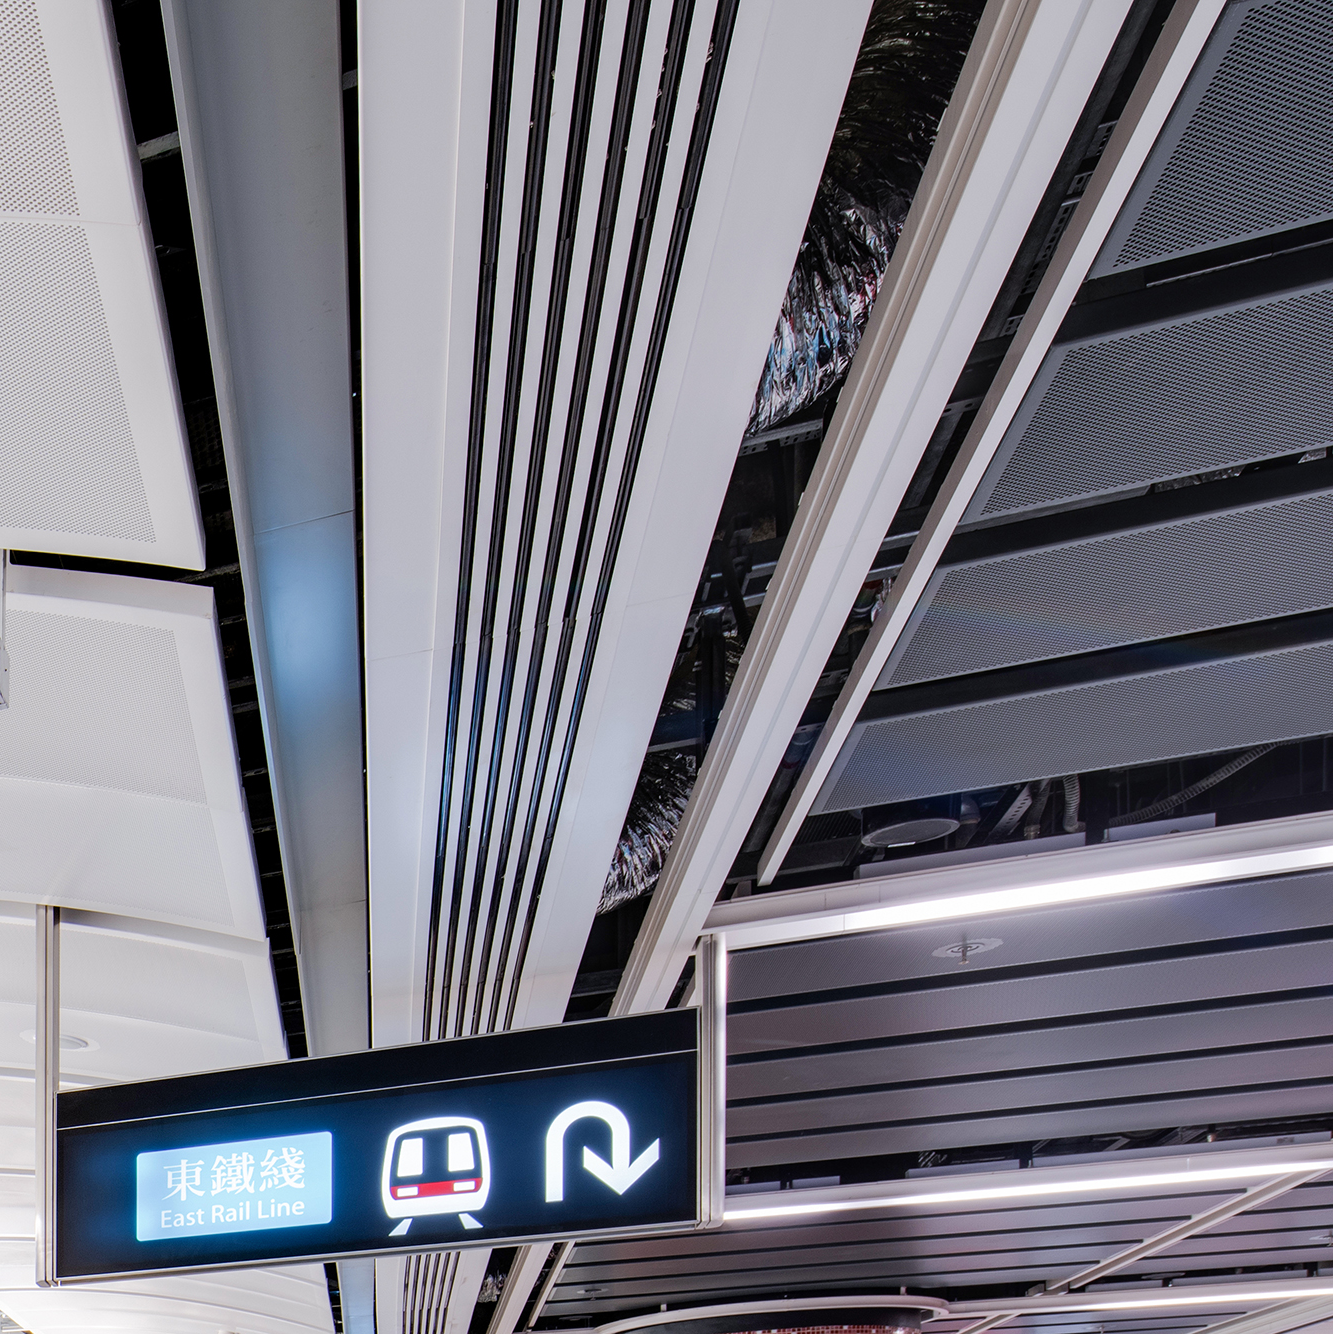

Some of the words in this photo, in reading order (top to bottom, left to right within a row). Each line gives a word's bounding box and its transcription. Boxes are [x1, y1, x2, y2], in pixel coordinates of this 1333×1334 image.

[162, 1147, 306, 1201] 東鐵綫
[161, 1209, 204, 1228] East
[211, 1200, 250, 1224] Rail
[258, 1199, 305, 1219] Line
